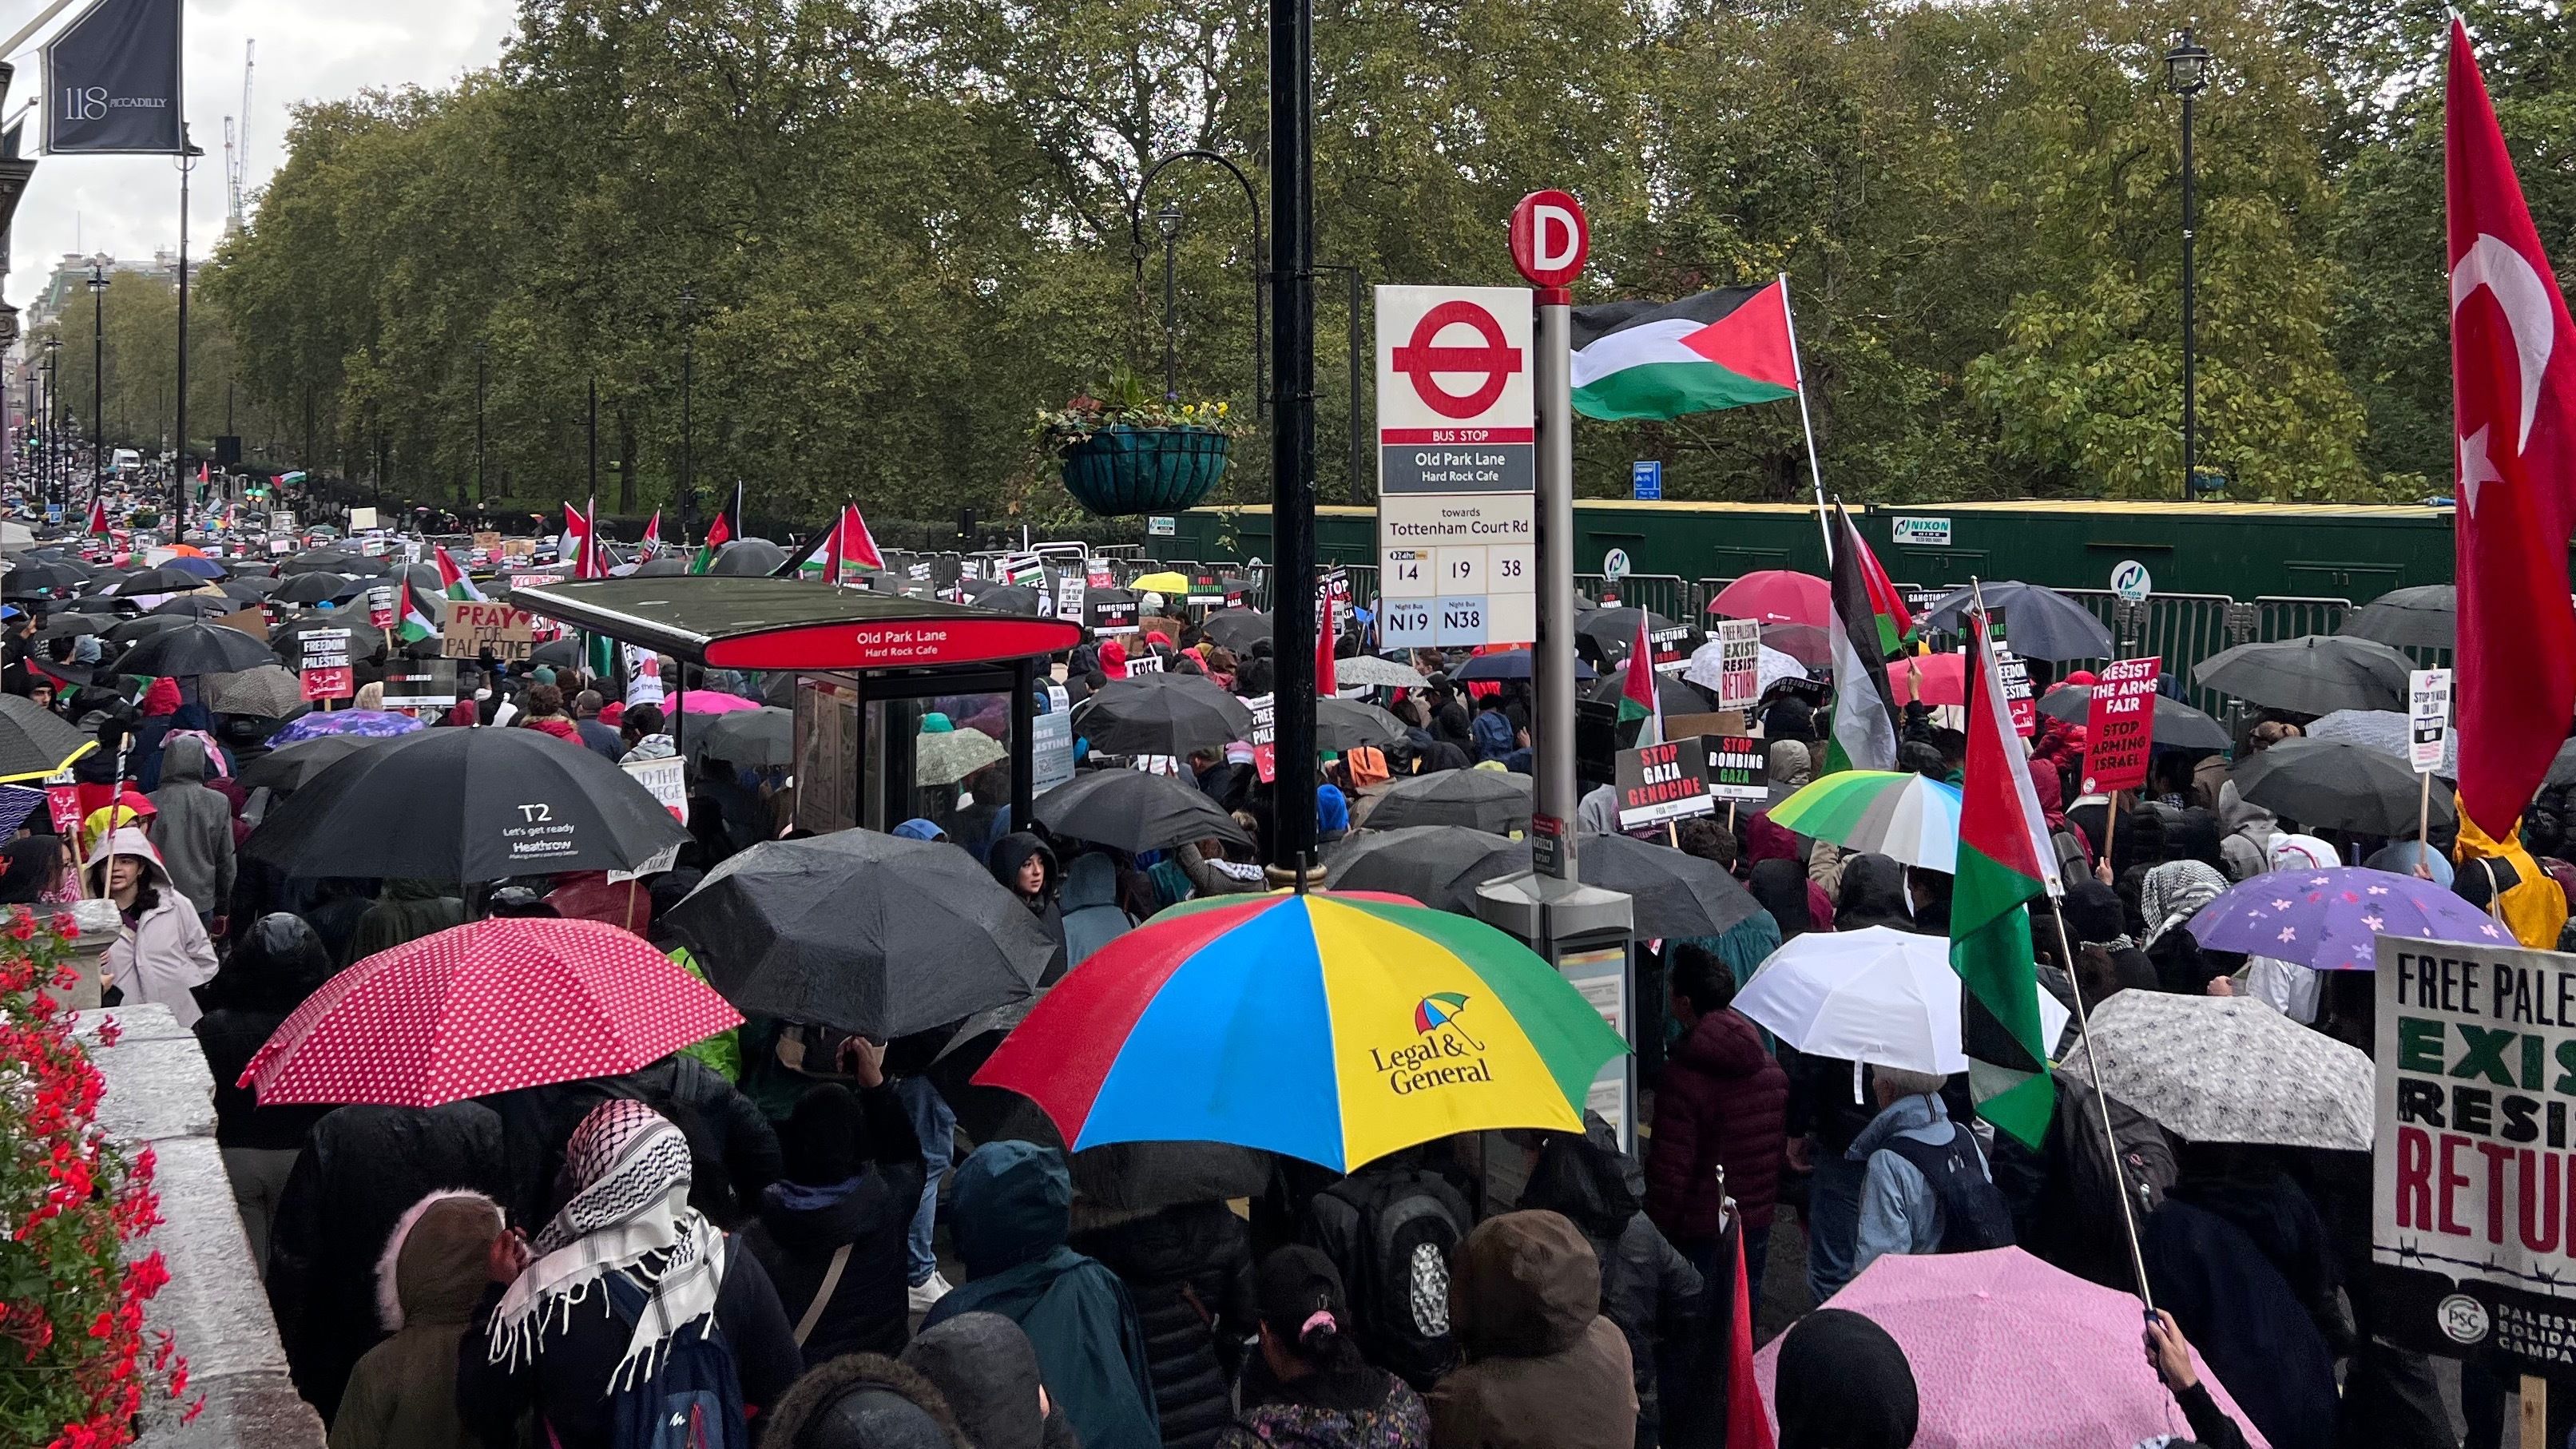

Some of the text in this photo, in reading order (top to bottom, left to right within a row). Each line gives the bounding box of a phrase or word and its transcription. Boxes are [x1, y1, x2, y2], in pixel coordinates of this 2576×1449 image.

[65, 86, 168, 121] 118 PICCADILLY
[1534, 204, 1580, 271] D
[1432, 430, 1489, 442] BUS STOP
[1415, 452, 1506, 466] Old Park Lane
[1422, 470, 1499, 482] Hard Rock Cafe
[1442, 508, 1481, 518] towards
[1390, 520, 1529, 536] Tottenham Court Rd
[1911, 520, 1949, 531] NIXON
[1399, 563, 1419, 581] 14
[1453, 561, 1471, 578] 19
[1502, 560, 1522, 577] 38
[1189, 585, 1223, 593] PALESTINE
[1097, 603, 1136, 613] SANCTIONS
[1395, 603, 1411, 612] Night
[456, 605, 518, 629] PRAY
[1390, 613, 1428, 631] N19
[1444, 611, 1480, 629] N38
[474, 626, 502, 641] FOR
[857, 629, 947, 645] Old Park Lane
[1650, 628, 1689, 644] ANCTIONS
[1723, 625, 1736, 641] FREE
[304, 638, 347, 653] FREEDOM
[865, 645, 939, 657] Hard Rock Cafe
[1662, 641, 1673, 652] ON
[302, 654, 349, 669] PALESTINE
[1998, 662, 2027, 678] EEDOM
[2102, 662, 2152, 682] RESIST
[2006, 682, 2032, 699] ESTINE
[2092, 677, 2158, 700] THE ARMS
[2106, 697, 2140, 714] FAIR
[2414, 692, 2430, 703] STOP
[2102, 721, 2140, 737] STOP
[1723, 737, 1753, 752] STOP
[2091, 736, 2146, 756] ARMING
[1640, 744, 1677, 767] STOP
[1709, 752, 1764, 769] BOMBING
[2094, 753, 2139, 772] ISRAEL
[657, 767, 681, 784] THE
[1642, 761, 1681, 785] GAZA
[1720, 768, 1750, 784] GAZA
[653, 784, 683, 802] IEGE
[1627, 776, 1701, 807] GENOCIDE
[518, 803, 553, 823] T2
[502, 823, 575, 837] Let's get ready
[512, 840, 572, 853] Heathrow
[2397, 952, 2479, 1014] FREE
[1368, 1033, 1471, 1073] Legal &
[1390, 1058, 1494, 1095] General
[2448, 1308, 2479, 1328] PSC
